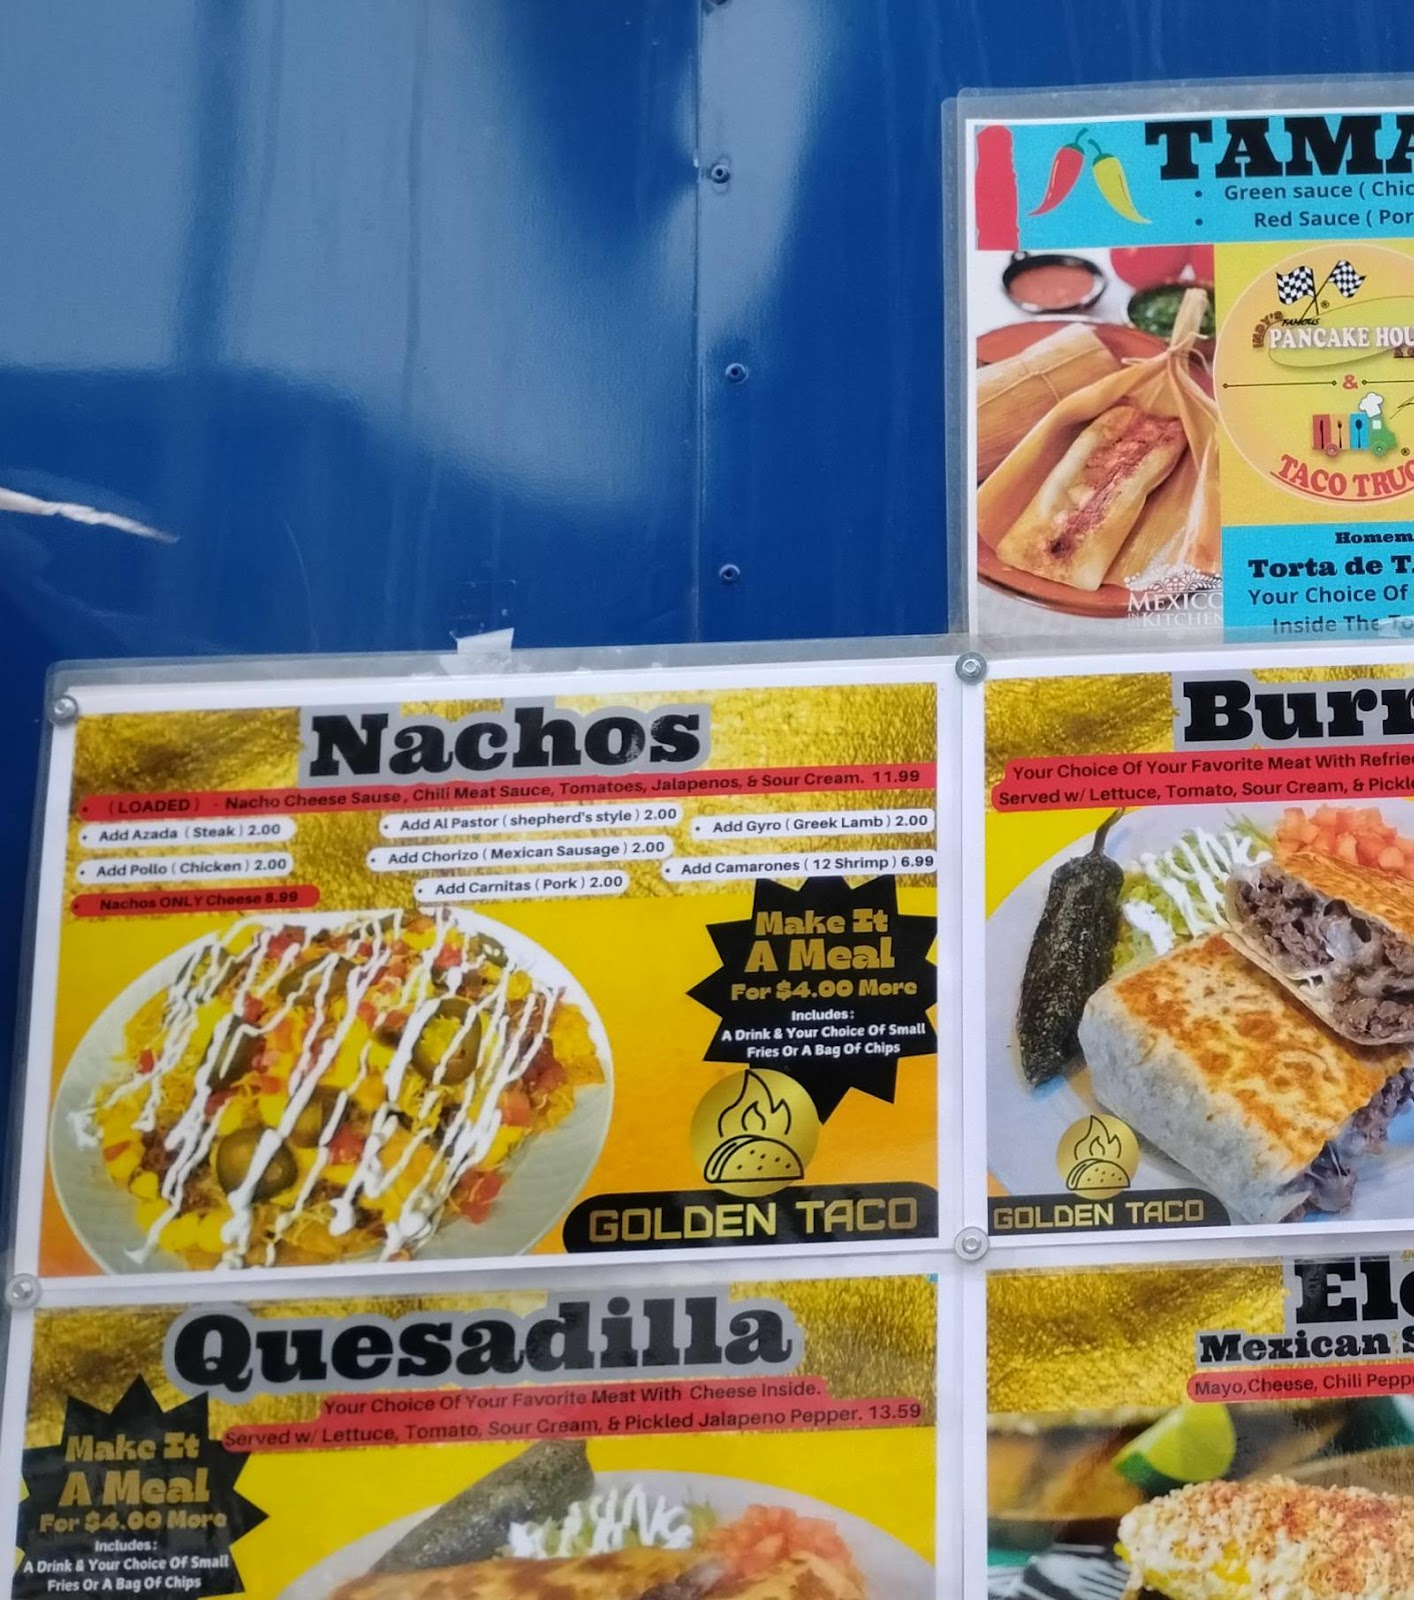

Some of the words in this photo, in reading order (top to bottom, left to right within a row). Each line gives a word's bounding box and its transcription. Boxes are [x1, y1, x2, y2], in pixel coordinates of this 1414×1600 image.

[1223, 184, 1286, 202] Green
[1292, 184, 1353, 200] sauce
[1253, 210, 1292, 229] Red
[1298, 210, 1360, 228] Sauce
[1269, 326, 1370, 349] PANCAKE
[1342, 374, 1358, 390] &
[1278, 453, 1348, 497] TACO
[1247, 557, 1338, 579] Torta
[1344, 555, 1383, 576] de
[1247, 588, 1299, 606] Your
[1304, 584, 1376, 604] Choice
[1382, 583, 1409, 602] Of
[1272, 616, 1338, 635] Inside
[309, 706, 700, 777] Nachos
[1012, 766, 1054, 781] Your
[1056, 762, 1119, 779] Choice
[1121, 759, 1143, 776] Of
[1145, 760, 1188, 775] Your
[1190, 756, 1264, 773] Favorite
[1267, 755, 1312, 771] Meat
[1314, 752, 1356, 770] With
[117, 798, 191, 816] LOADED
[223, 794, 281, 812] Nacho
[282, 787, 348, 809] Cheese
[413, 786, 451, 803] Chili
[459, 784, 496, 801] Meat
[499, 784, 555, 800] Sauce,
[558, 780, 647, 796] Tomatoes,
[650, 777, 742, 794] Jalapenos,
[746, 774, 758, 788] &
[761, 773, 800, 788] Sour
[803, 772, 864, 786] Cream.
[872, 769, 921, 784] 11.99
[998, 788, 1061, 807] Served
[1063, 788, 1085, 803] w/
[1089, 786, 1161, 802] Lettuce,
[1165, 783, 1237, 805] Tomato,
[1241, 781, 1283, 797] Sour
[1285, 779, 1348, 800] Cream,
[1351, 777, 1365, 793] &
[99, 896, 157, 912] Nachos
[158, 895, 203, 909] ONLY
[205, 893, 262, 907] Cheese
[264, 890, 298, 905] 8.99
[754, 909, 846, 937] Make
[852, 907, 888, 934] It
[743, 939, 778, 973] A
[787, 935, 895, 972] Meal
[730, 982, 772, 1002] For
[775, 978, 854, 1002] $4.00
[857, 978, 918, 997] More
[589, 1201, 777, 1243] GOLDEN
[794, 1196, 917, 1234] TACO
[174, 1296, 793, 1392] Quesadilla
[1199, 1328, 1391, 1364] Mexican
[1322, 1372, 1362, 1391] Chili
[324, 1400, 365, 1416] Your
[370, 1398, 435, 1413] Choice
[439, 1396, 460, 1411] Of
[466, 1395, 509, 1410] Your
[512, 1390, 587, 1407] Favorite
[590, 1388, 638, 1404] Meat
[640, 1385, 682, 1403] With
[689, 1383, 758, 1401] Cheese
[761, 1381, 822, 1398] Inside.
